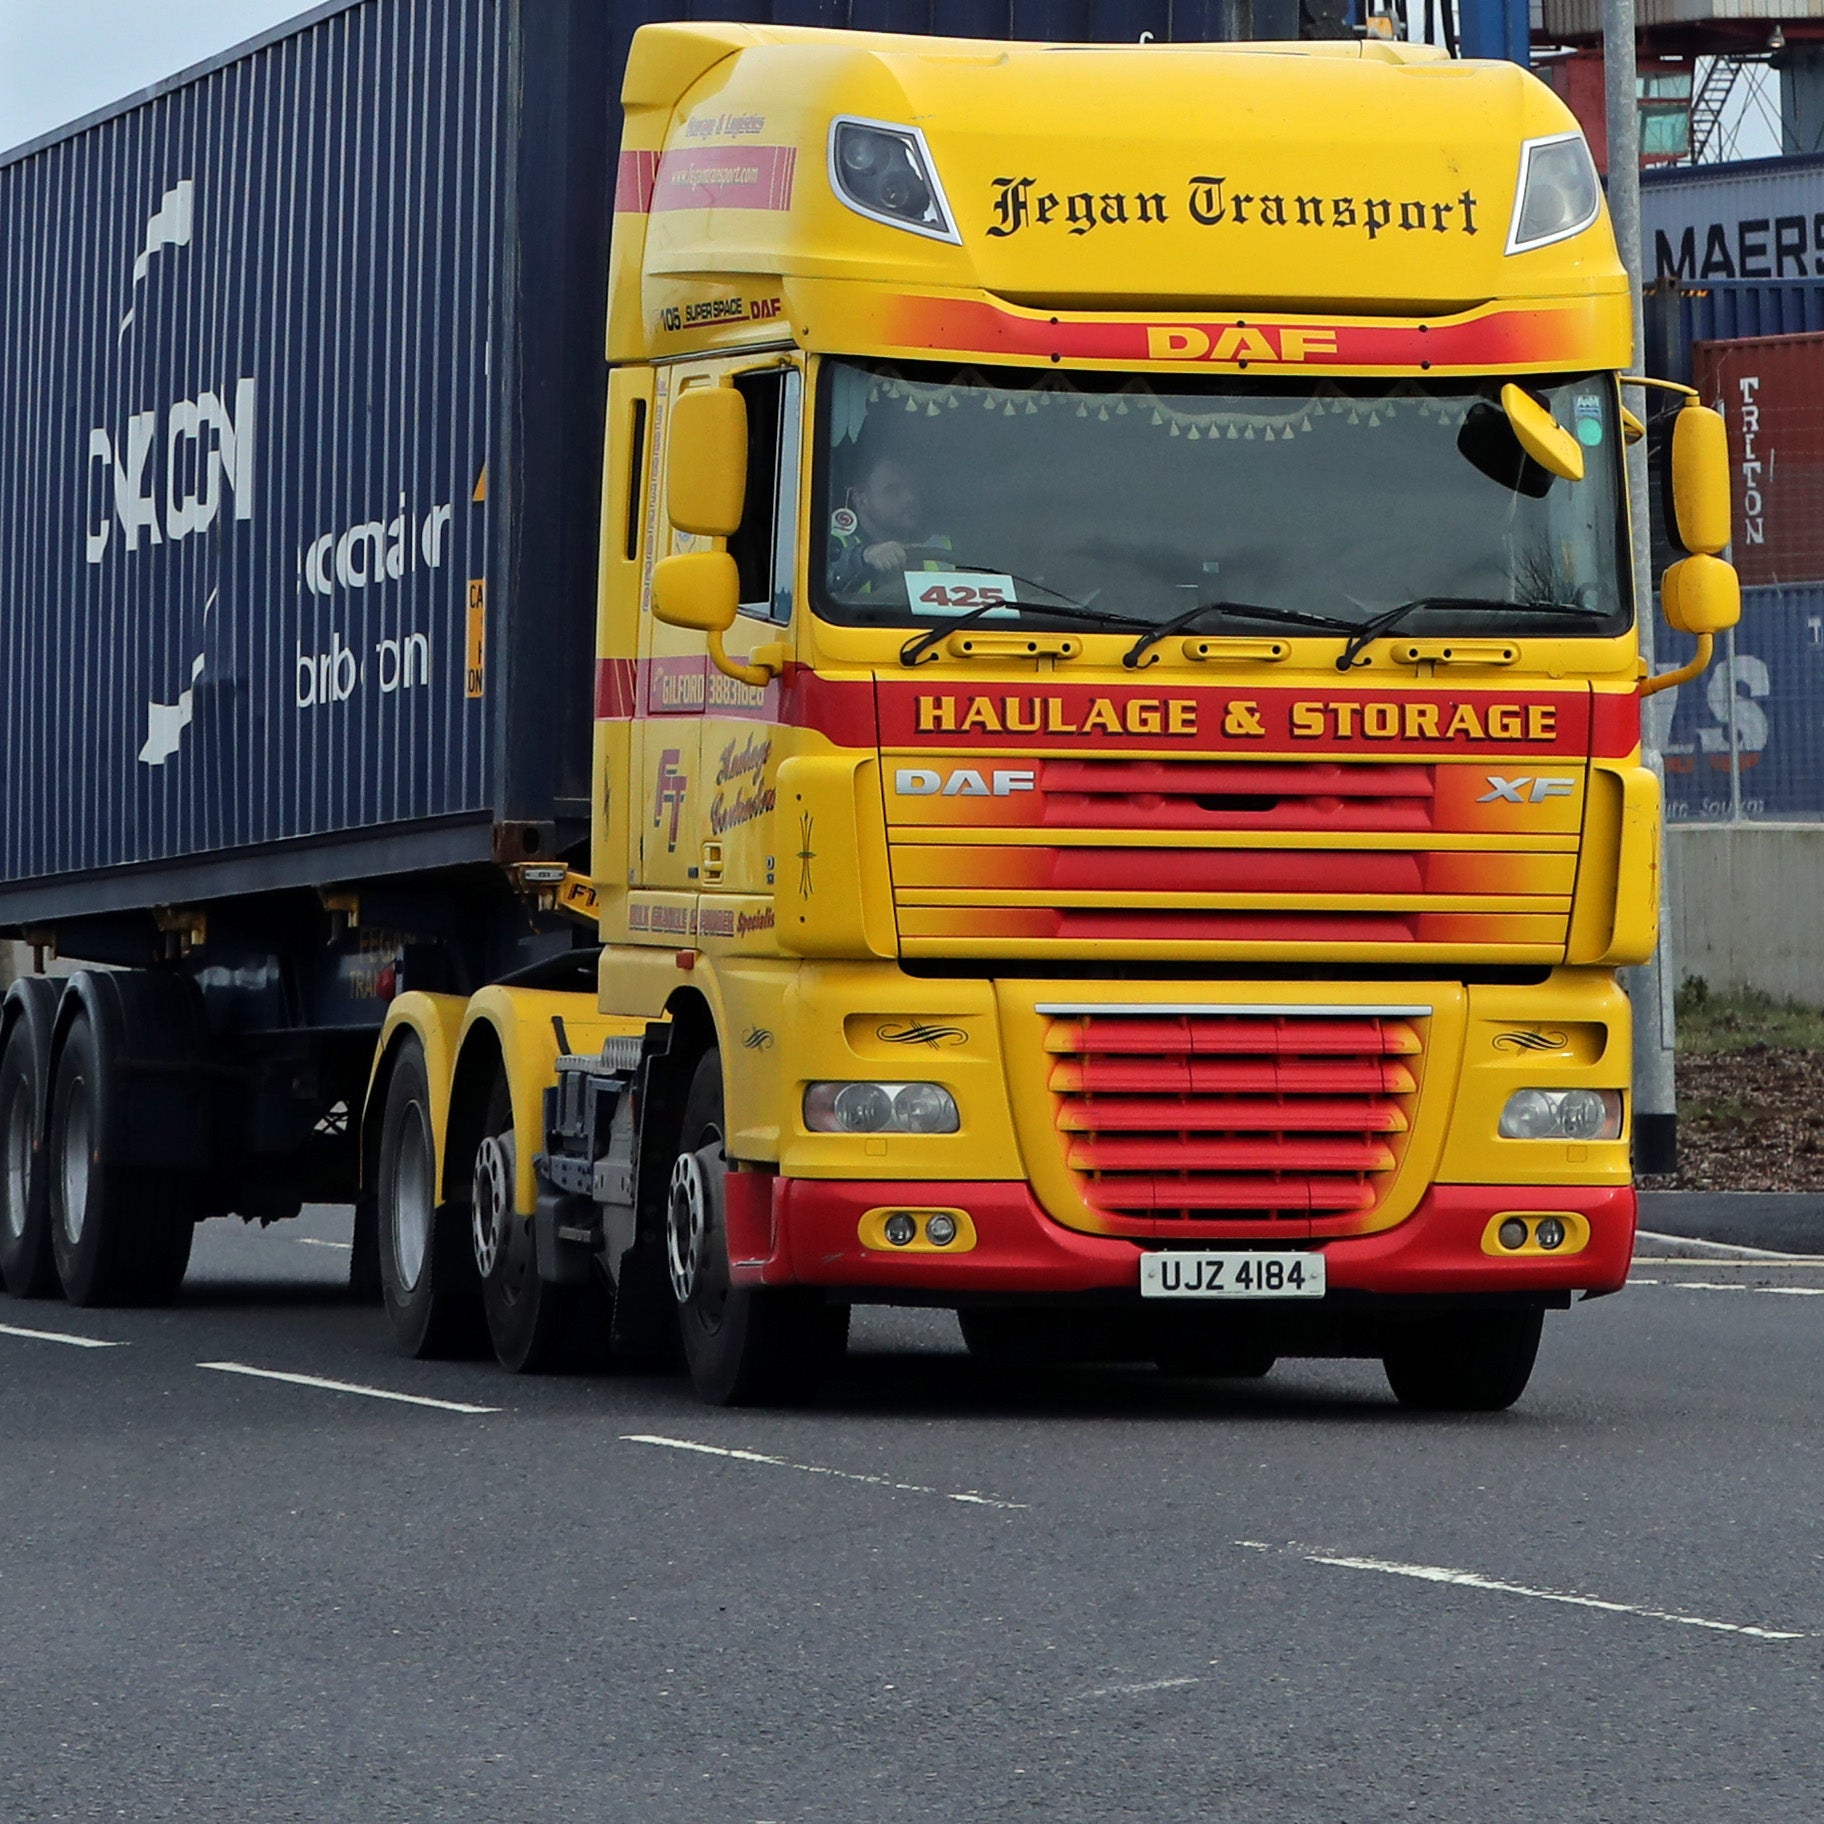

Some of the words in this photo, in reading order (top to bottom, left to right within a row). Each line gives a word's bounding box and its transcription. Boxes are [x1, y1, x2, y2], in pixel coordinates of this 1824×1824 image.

[985, 177, 1169, 237] Fegan
[1188, 176, 1478, 239] Transport
[750, 297, 781, 320] DAF
[1146, 326, 1337, 361] DAF
[1739, 377, 1765, 545] TRITON
[919, 585, 1005, 608] 425
[916, 695, 1198, 738] HAULAGE
[1222, 699, 1265, 738] &
[1292, 701, 1557, 743] STORAGE
[895, 769, 1035, 796] DAF
[1476, 777, 1576, 804] XF
[1161, 1260, 1225, 1291] UJZ
[1235, 1260, 1305, 1291] 4184
